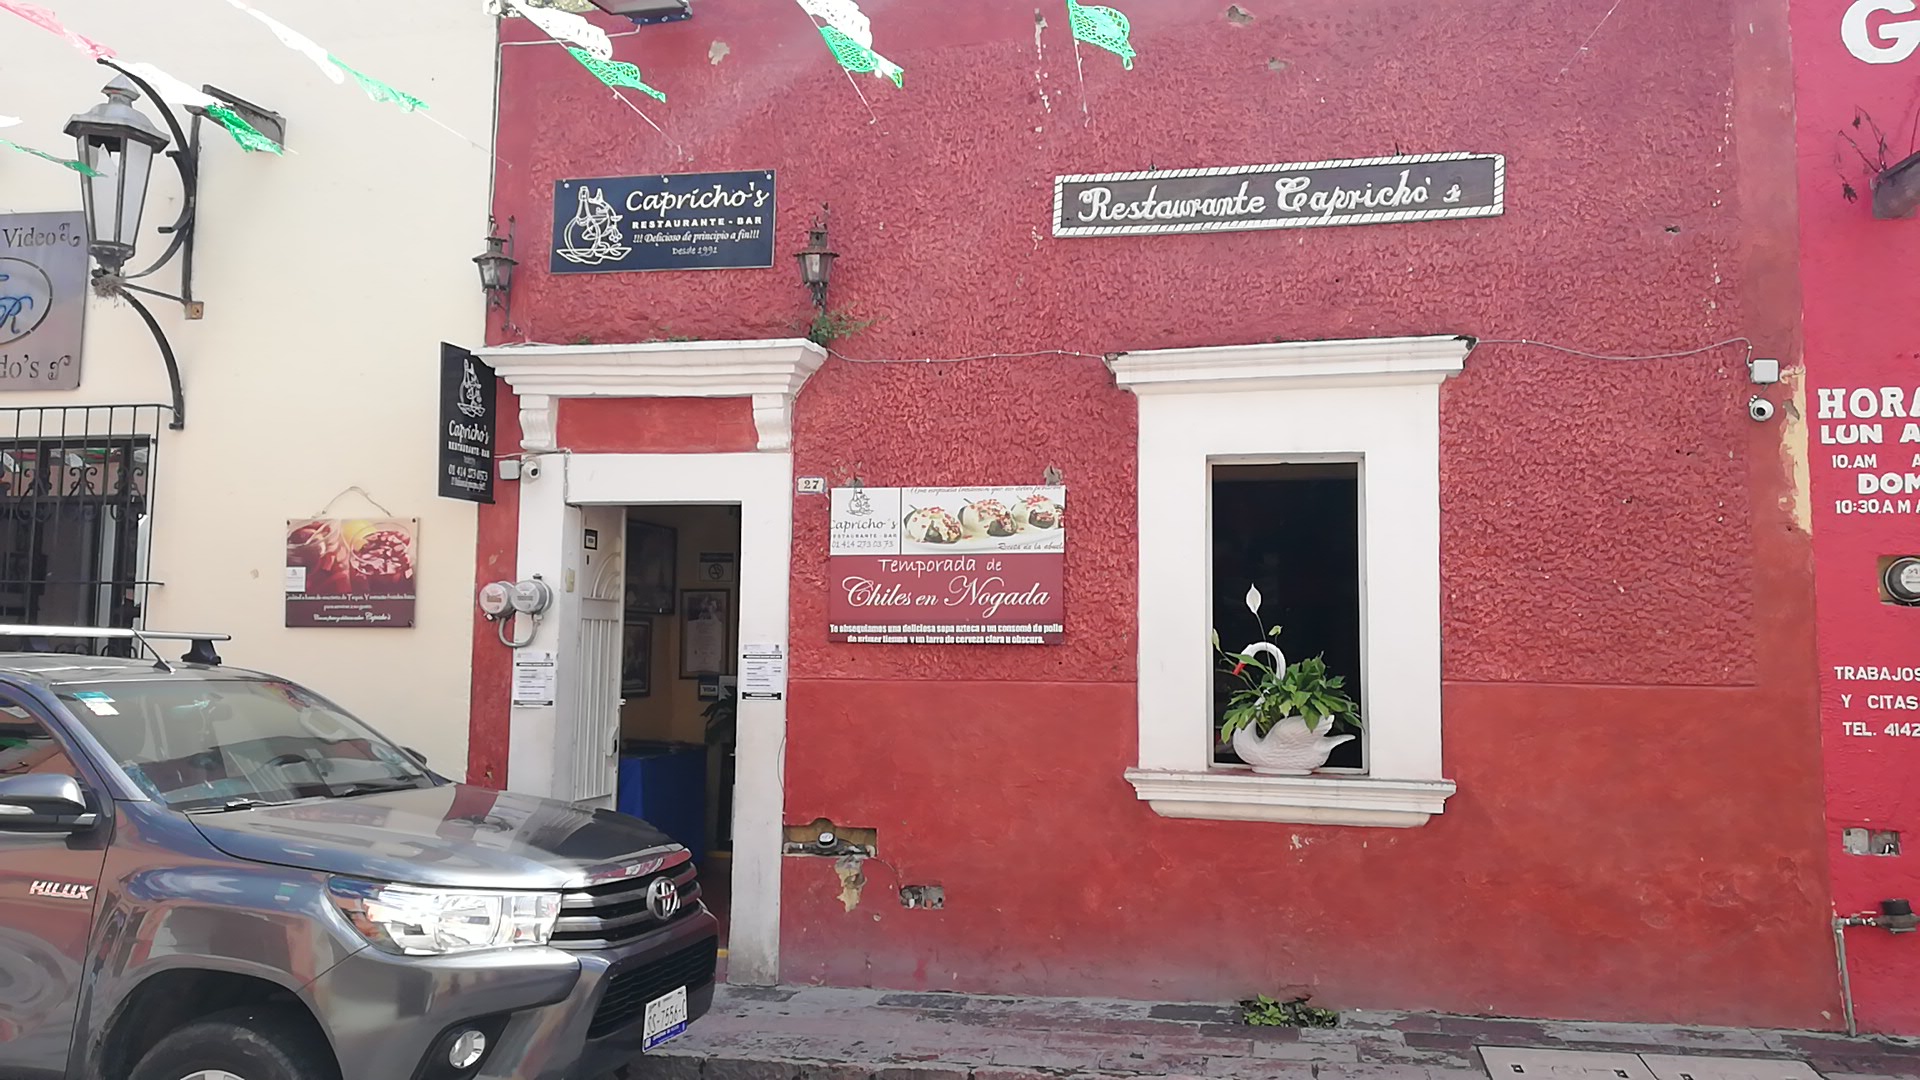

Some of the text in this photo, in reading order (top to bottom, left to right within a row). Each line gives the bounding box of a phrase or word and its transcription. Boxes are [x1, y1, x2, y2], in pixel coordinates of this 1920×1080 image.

[1841, 0, 1920, 65] G
[626, 182, 769, 217] Capricho's
[1078, 180, 1266, 222] Restaurante
[632, 218, 725, 229] RESTAURANTE
[737, 217, 762, 225] BAR
[2, 227, 56, 248] Video
[644, 232, 681, 244] Delicioso
[682, 231, 692, 242] de
[692, 230, 729, 244] principio
[730, 232, 736, 240] a
[448, 420, 489, 444] Capricho's
[1820, 424, 1883, 444] LUN
[804, 480, 819, 489] 27
[877, 556, 1002, 578] Temporada de
[842, 575, 1051, 618] Chiles en Nogada
[888, 625, 901, 633] una
[902, 624, 936, 633] deliciosa
[956, 624, 980, 633] azteca
[987, 625, 997, 633] un
[1032, 624, 1042, 632] de
[1043, 624, 1063, 633] pollo
[955, 636, 985, 644] cerveza
[985, 635, 1005, 644] clara
[1841, 694, 1919, 710] Y CITAS
[1842, 722, 1877, 736] TEL.
[29, 880, 93, 900] HILUX
